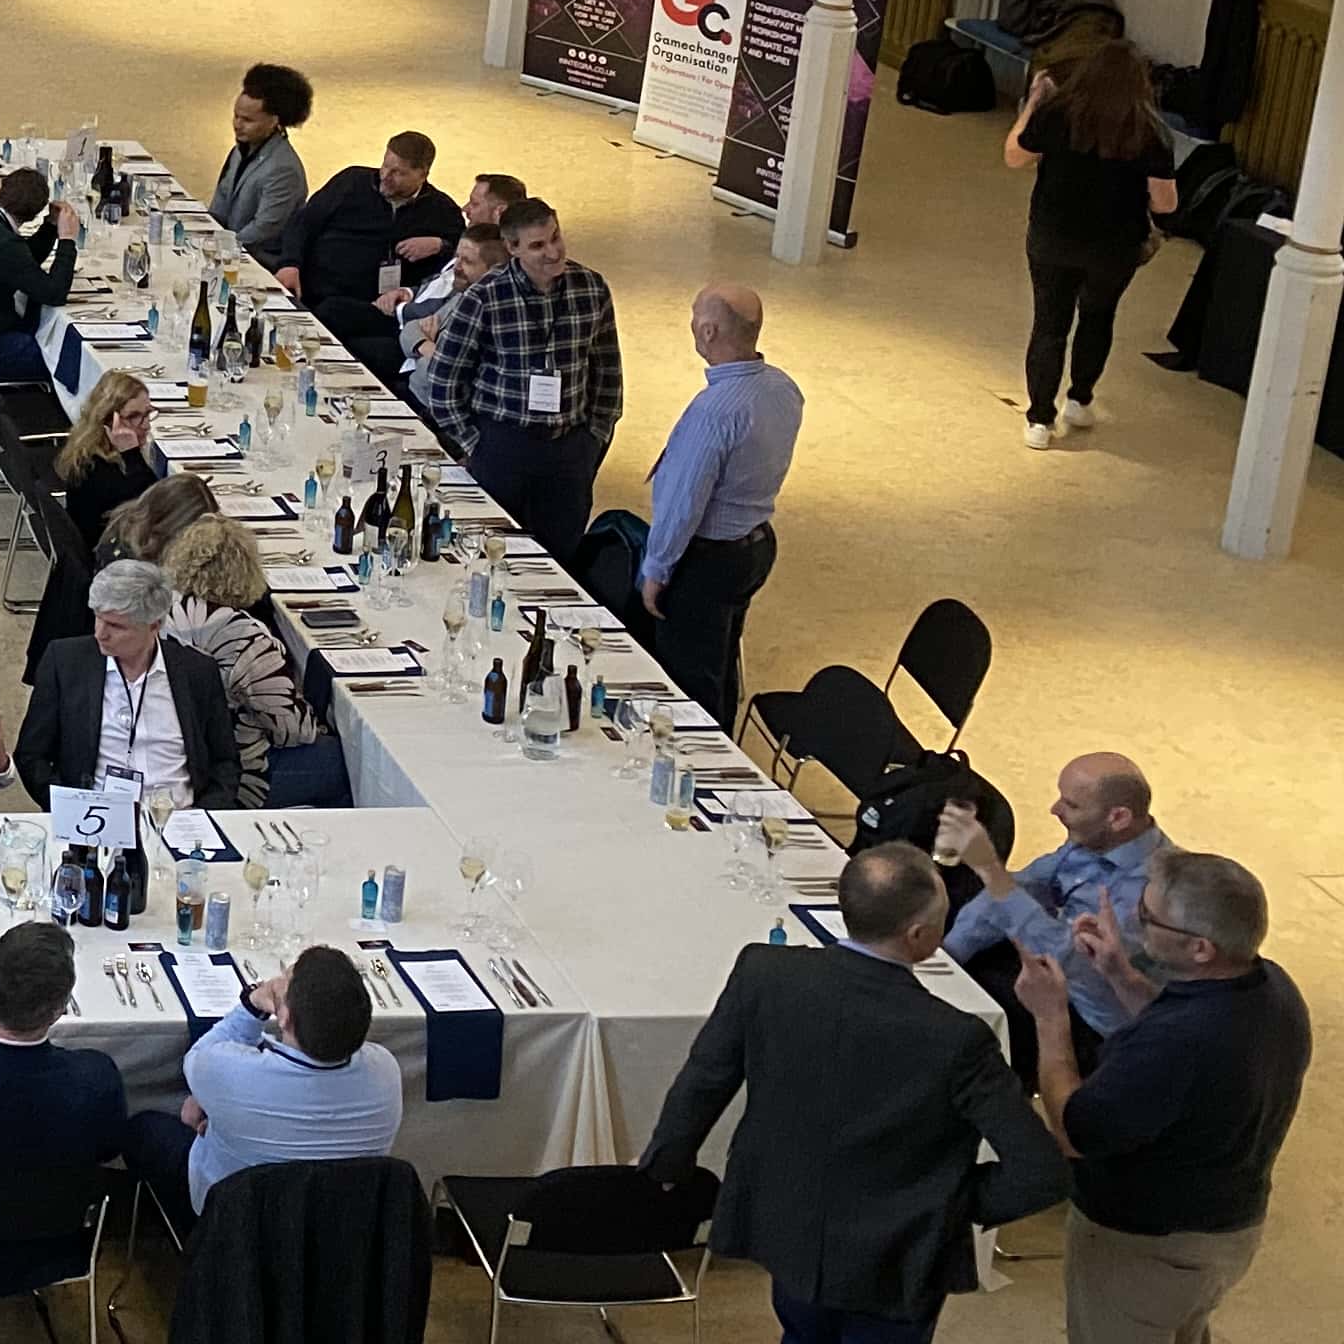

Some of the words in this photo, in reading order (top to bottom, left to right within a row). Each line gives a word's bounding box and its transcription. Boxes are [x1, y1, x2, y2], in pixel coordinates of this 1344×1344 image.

[752, 12, 795, 30] BREAKFAST
[750, 36, 782, 52] INTIMATE
[751, 23, 798, 44] WORKSHOPS
[653, 31, 739, 64] Gamechanger
[747, 47, 763, 58] AND
[652, 44, 728, 75] Organisation
[369, 449, 388, 475] 3
[75, 805, 110, 836] 5
